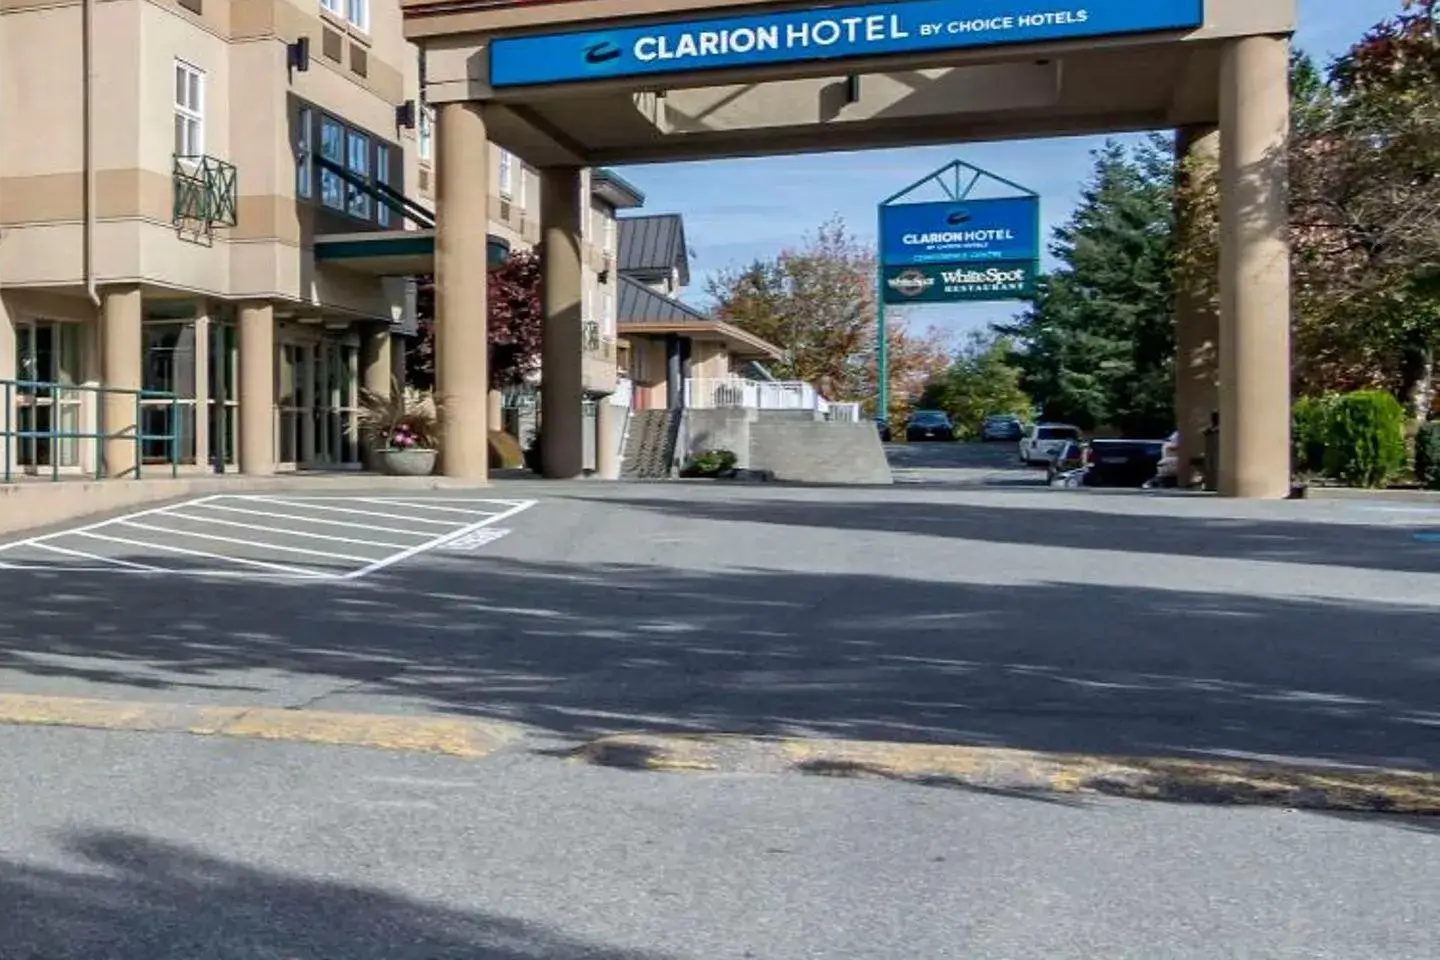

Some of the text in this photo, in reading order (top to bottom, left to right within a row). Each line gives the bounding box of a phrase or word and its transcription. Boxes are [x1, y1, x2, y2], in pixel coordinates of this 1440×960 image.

[634, 9, 1088, 61] CLARION HOTEL BY CHOICE HOTELS
[903, 229, 1014, 244] CLARION HOTEL
